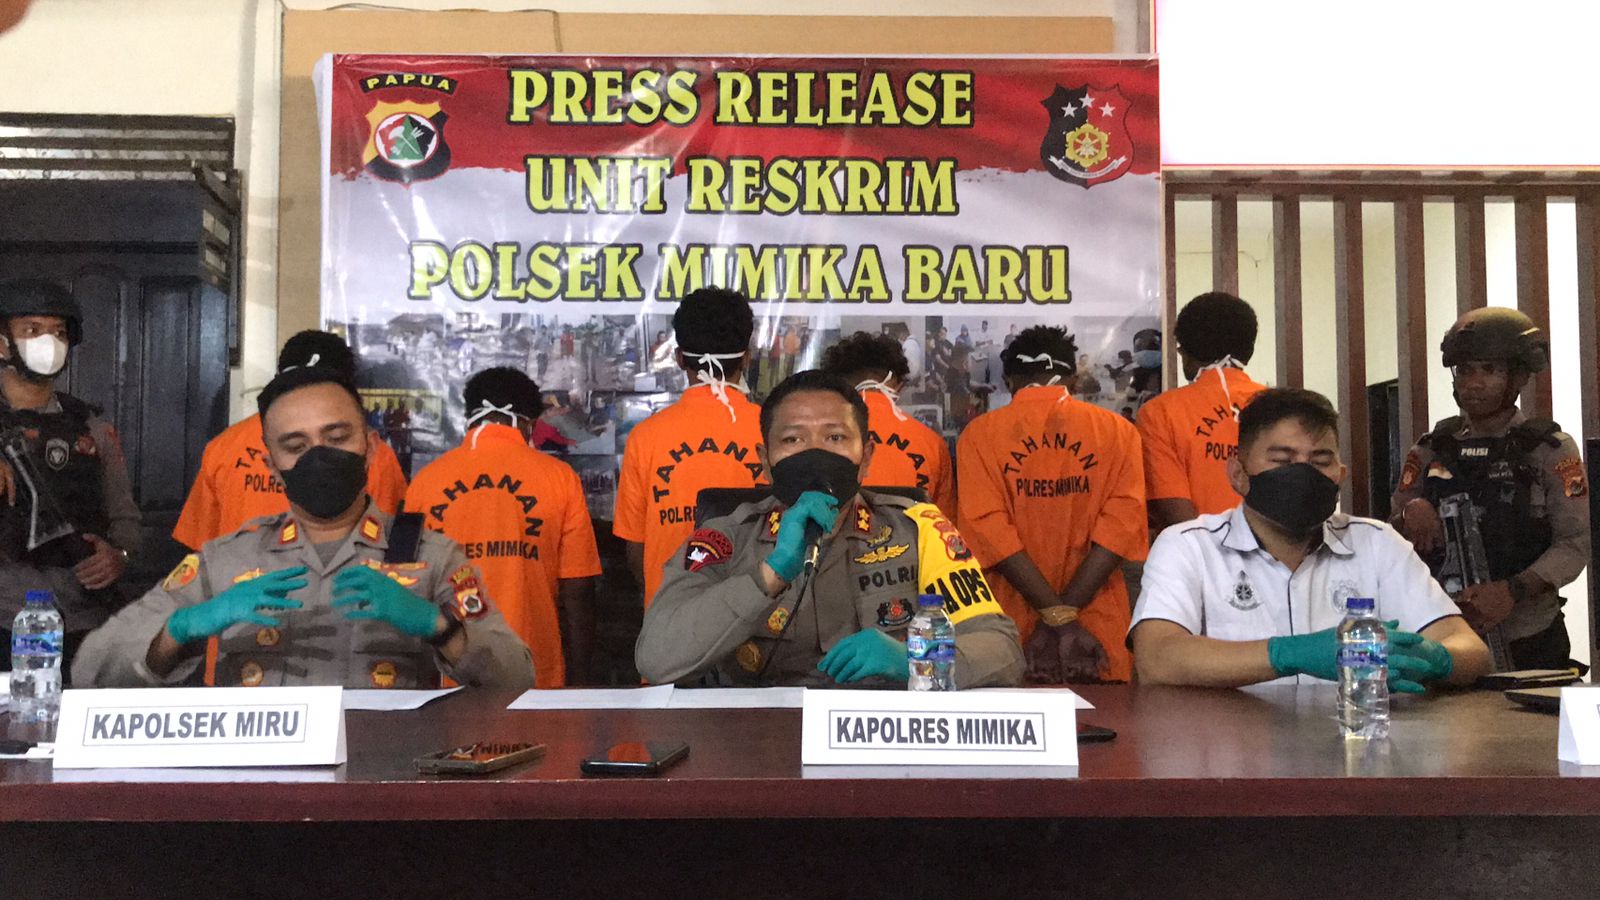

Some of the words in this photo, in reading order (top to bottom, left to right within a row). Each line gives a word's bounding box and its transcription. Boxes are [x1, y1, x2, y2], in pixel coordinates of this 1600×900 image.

[366, 74, 451, 90] PAPUA
[507, 68, 699, 127] PRESS
[713, 69, 975, 127] RELEASE
[525, 155, 675, 214] UNIT
[685, 155, 959, 216] RESKRIM
[408, 240, 645, 301] POLSEK
[654, 242, 892, 303] MIMIKA
[902, 244, 1071, 304] BARU
[1004, 433, 1098, 471] TAHANAN
[1461, 448, 1489, 457] POLISI
[244, 474, 286, 494] POLRE
[652, 438, 763, 503] TAHANA
[486, 541, 539, 561] MIMIKA
[859, 565, 916, 592] POLRI
[948, 567, 992, 608] OPS
[92, 712, 228, 739] KAPOLSEK
[235, 710, 299, 737] MIRU
[837, 716, 949, 744] KAPOLRES
[956, 718, 1037, 745] MIMIKA
